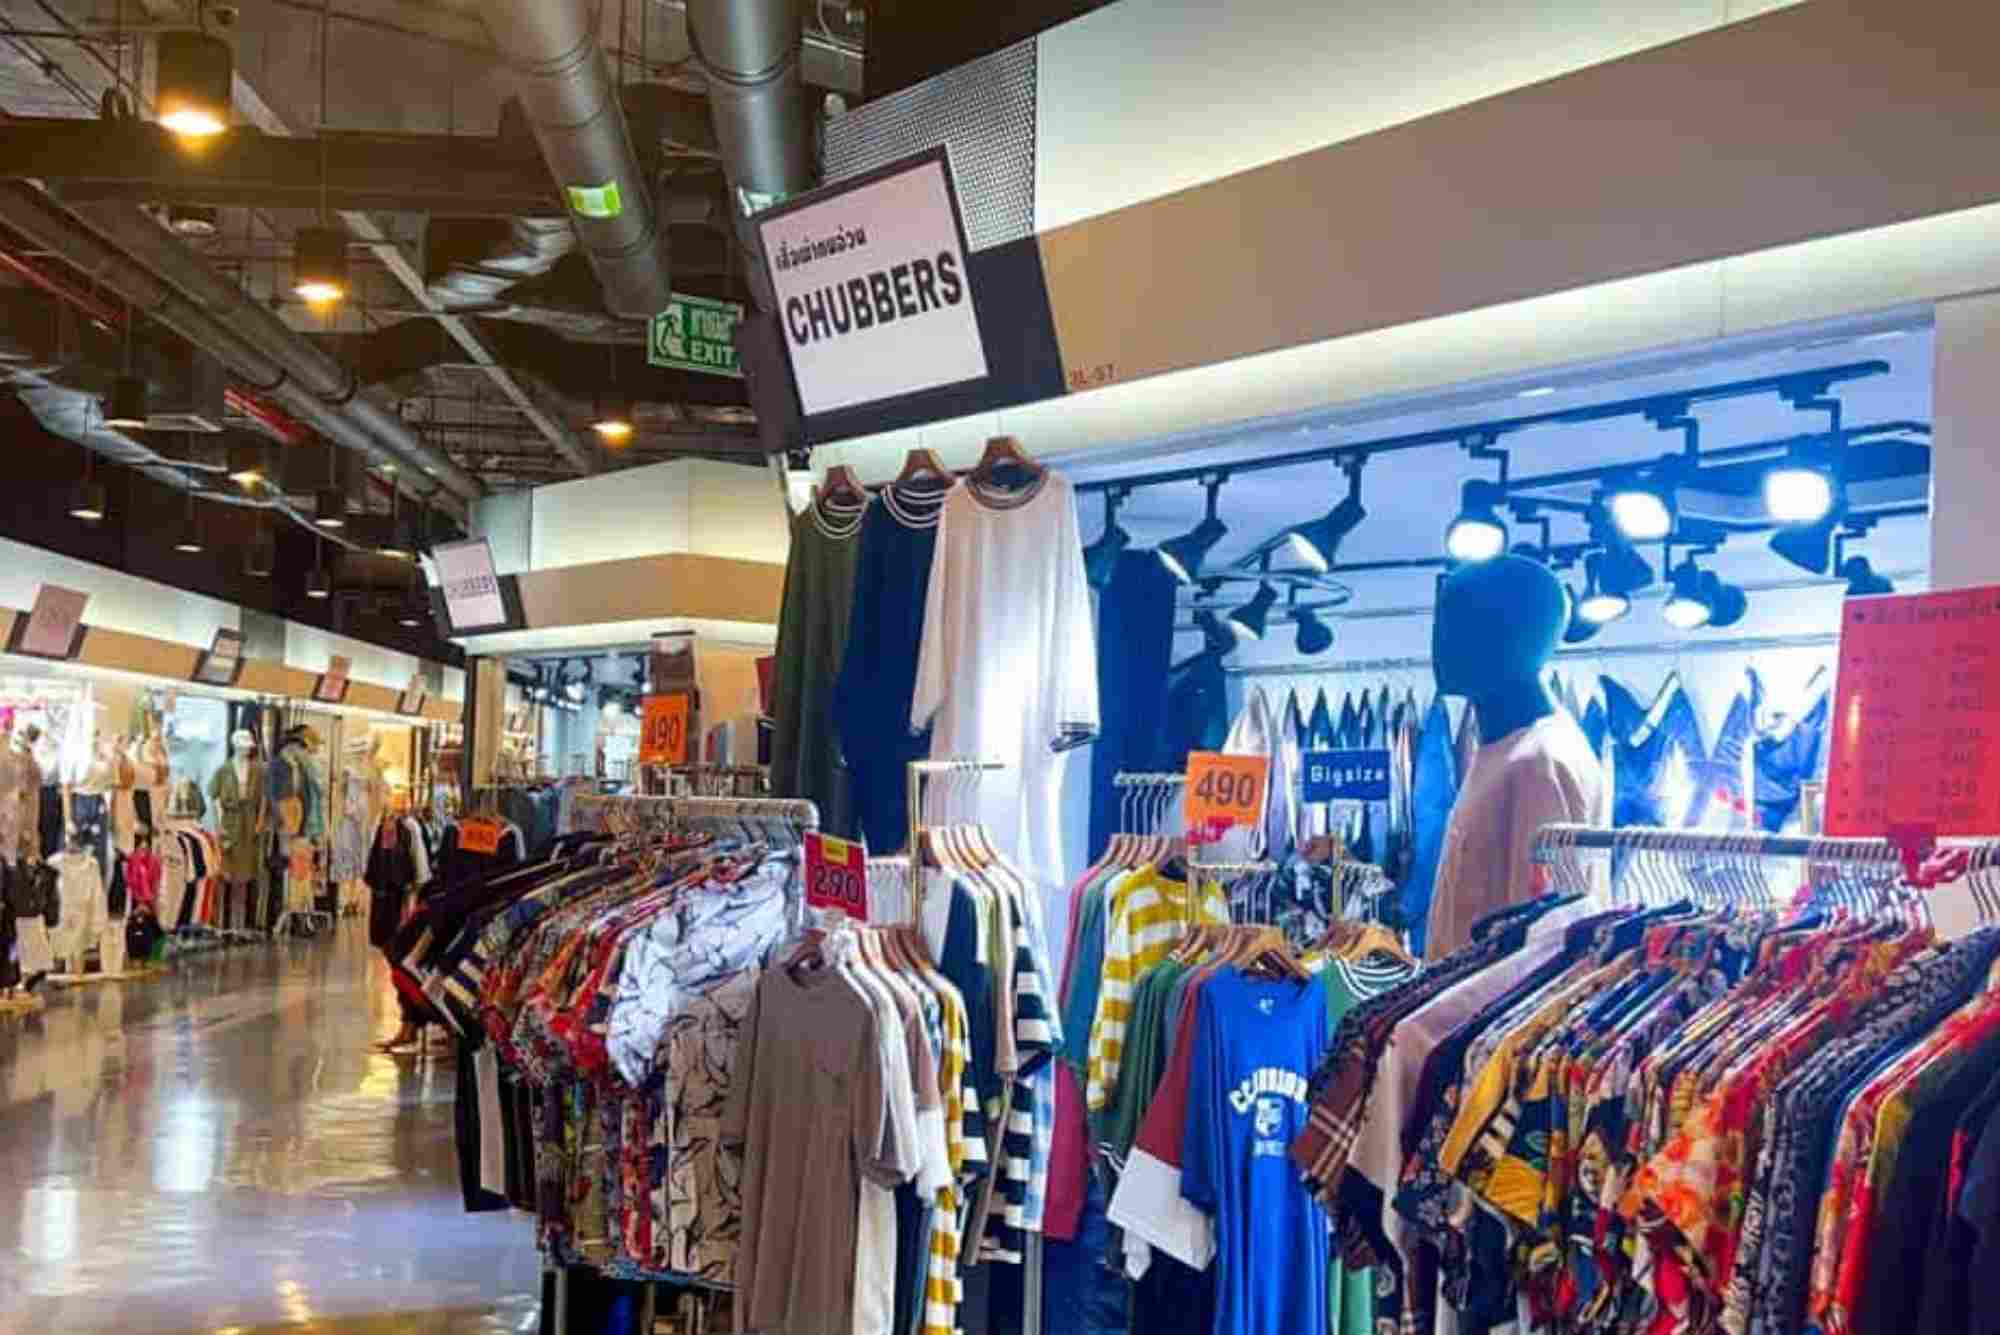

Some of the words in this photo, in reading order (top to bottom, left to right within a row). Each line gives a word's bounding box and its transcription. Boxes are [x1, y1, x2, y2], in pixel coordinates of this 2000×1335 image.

[786, 251, 962, 346] CHUBBERS
[691, 340, 734, 365] EXIT
[1195, 768, 1257, 807] 490
[814, 864, 862, 903] 290
